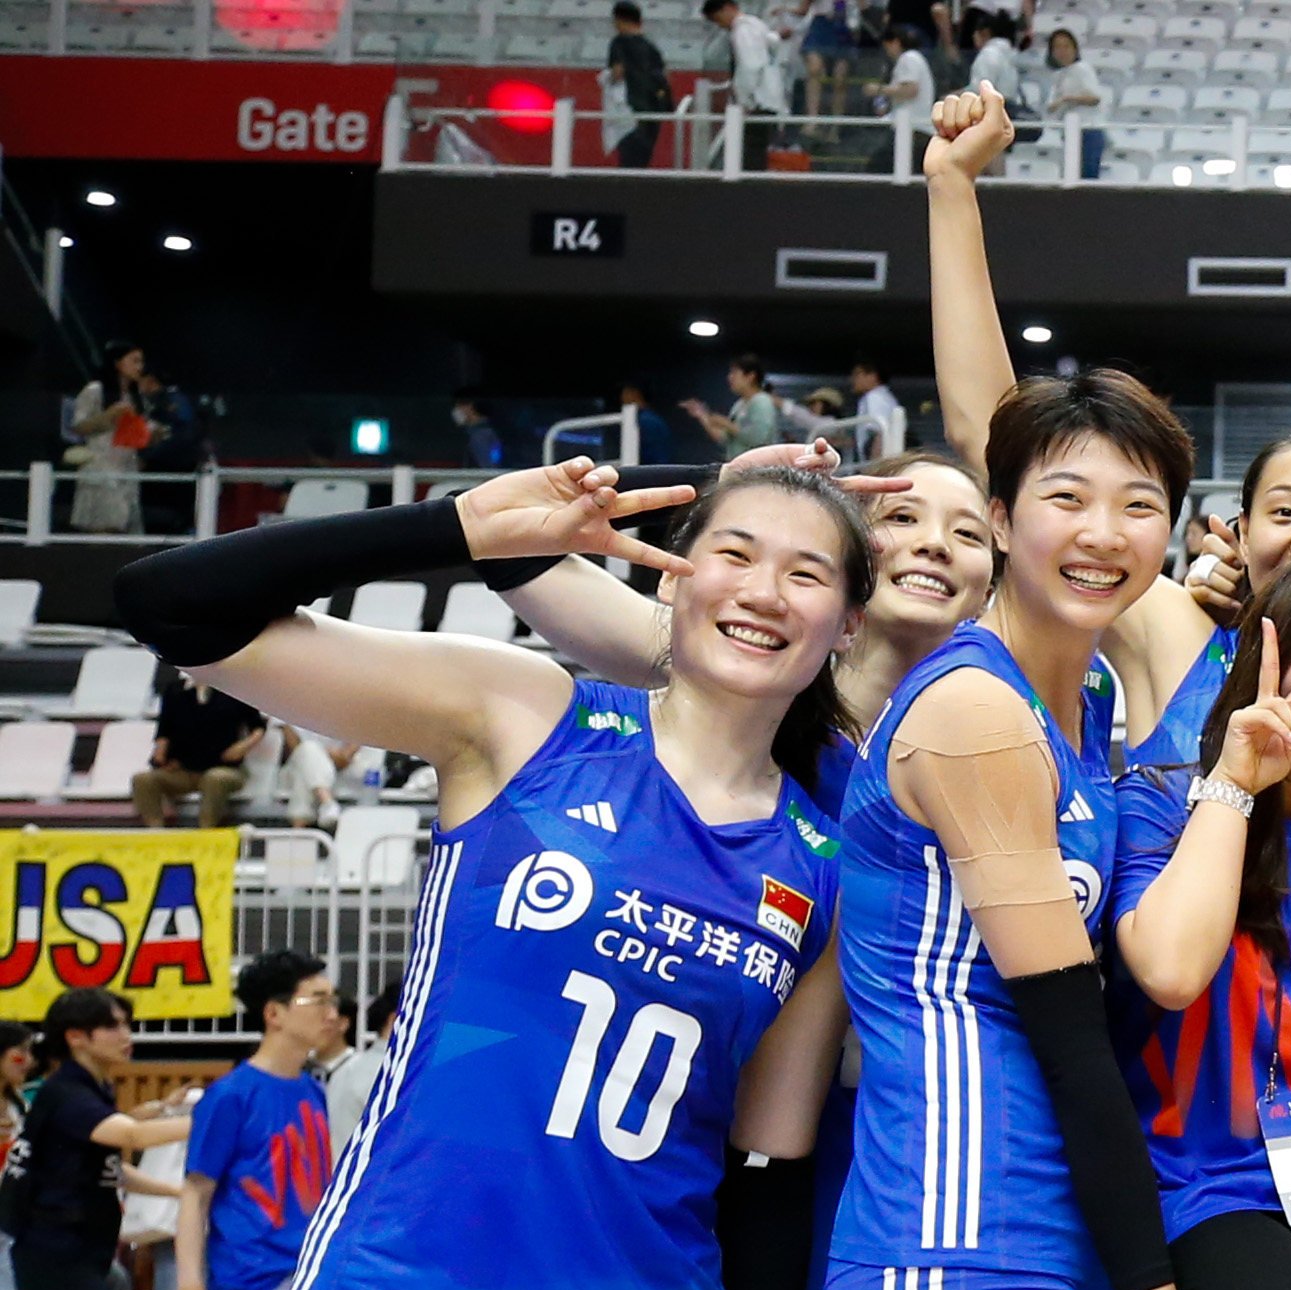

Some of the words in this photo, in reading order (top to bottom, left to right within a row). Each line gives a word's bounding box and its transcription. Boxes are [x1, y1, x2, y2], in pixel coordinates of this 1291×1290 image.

[237, 97, 370, 153] Gate
[553, 217, 602, 252] R4
[593, 928, 684, 983] CPIC
[764, 911, 801, 945] CHN
[545, 968, 703, 1162] 10
